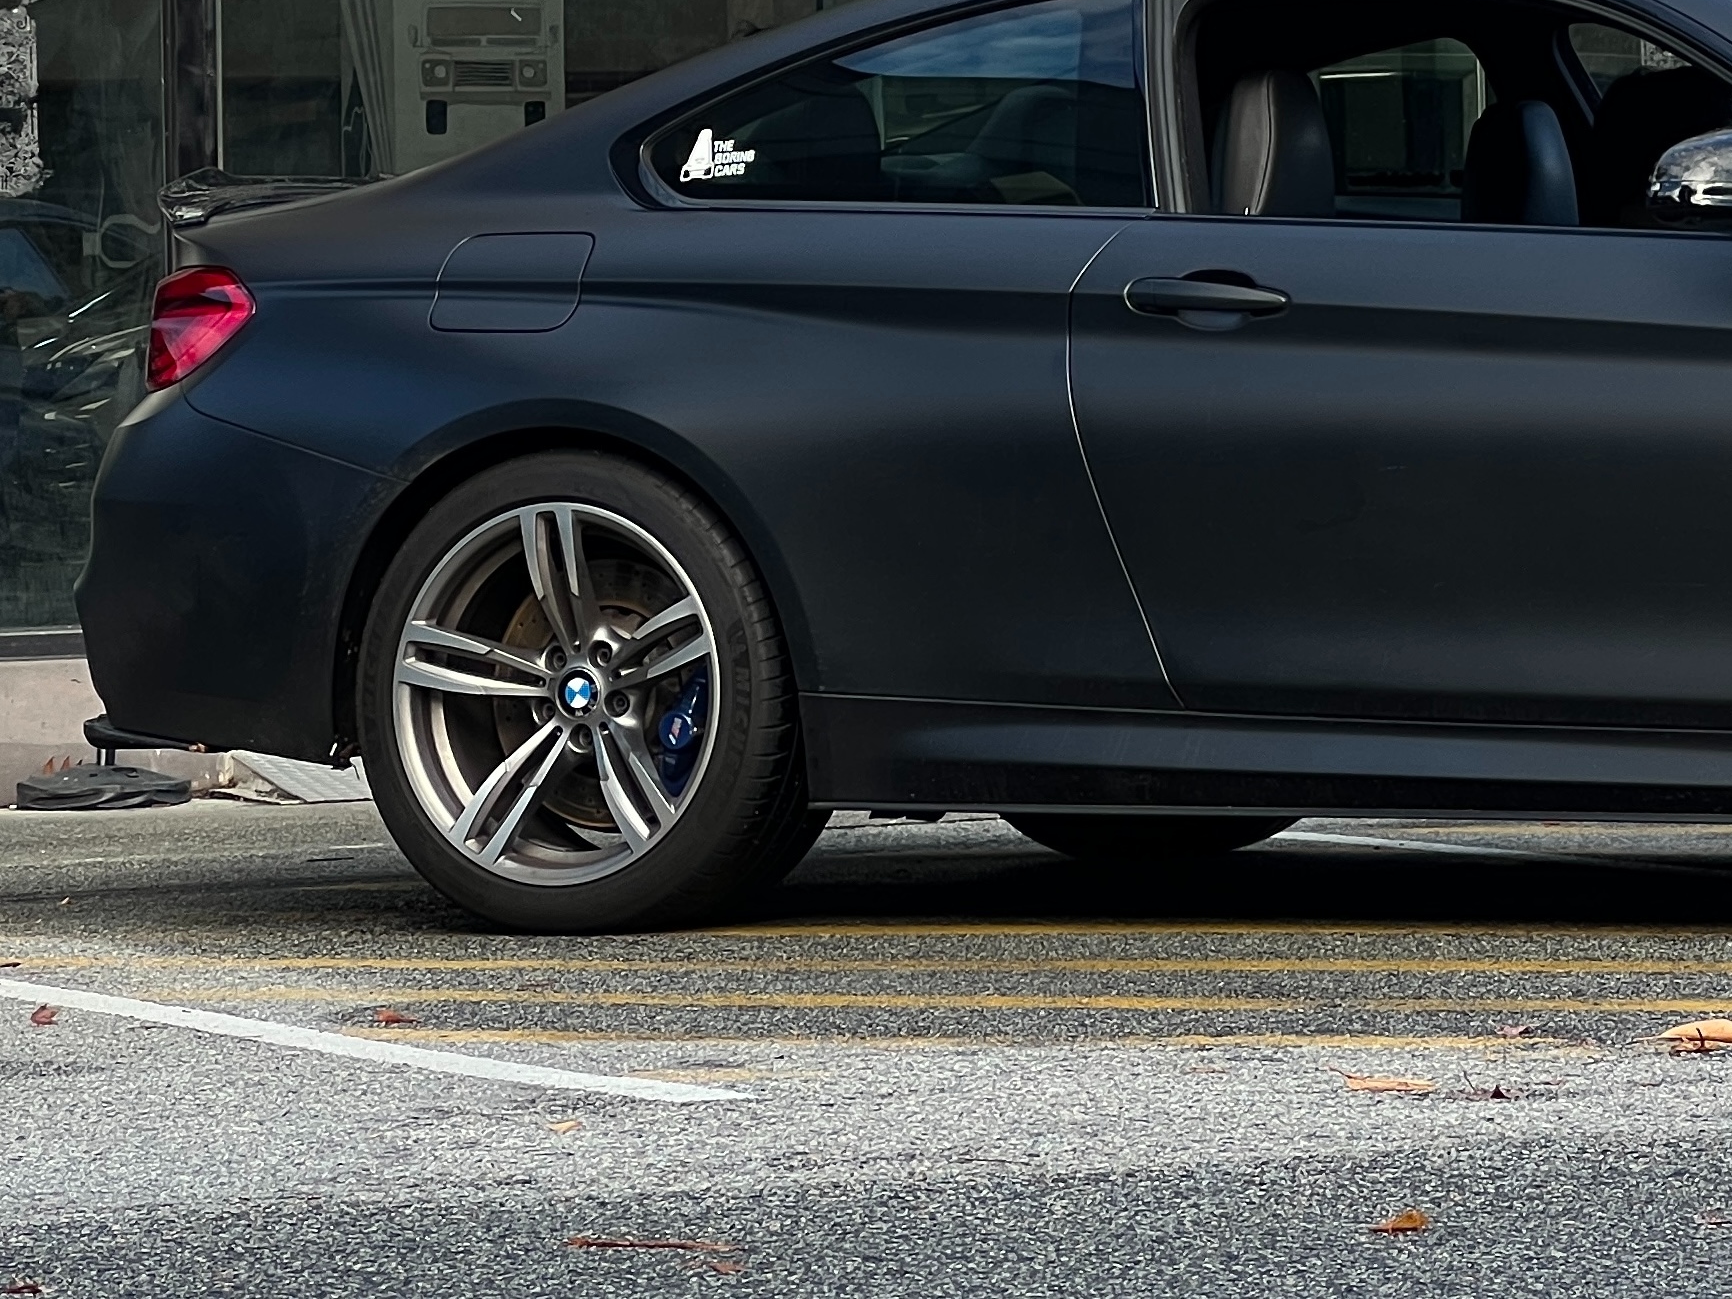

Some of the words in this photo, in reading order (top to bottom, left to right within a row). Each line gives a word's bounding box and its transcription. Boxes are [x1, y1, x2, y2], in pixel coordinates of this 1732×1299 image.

[713, 139, 735, 152] THE
[714, 149, 756, 164] BORING
[714, 163, 746, 177] CARS
